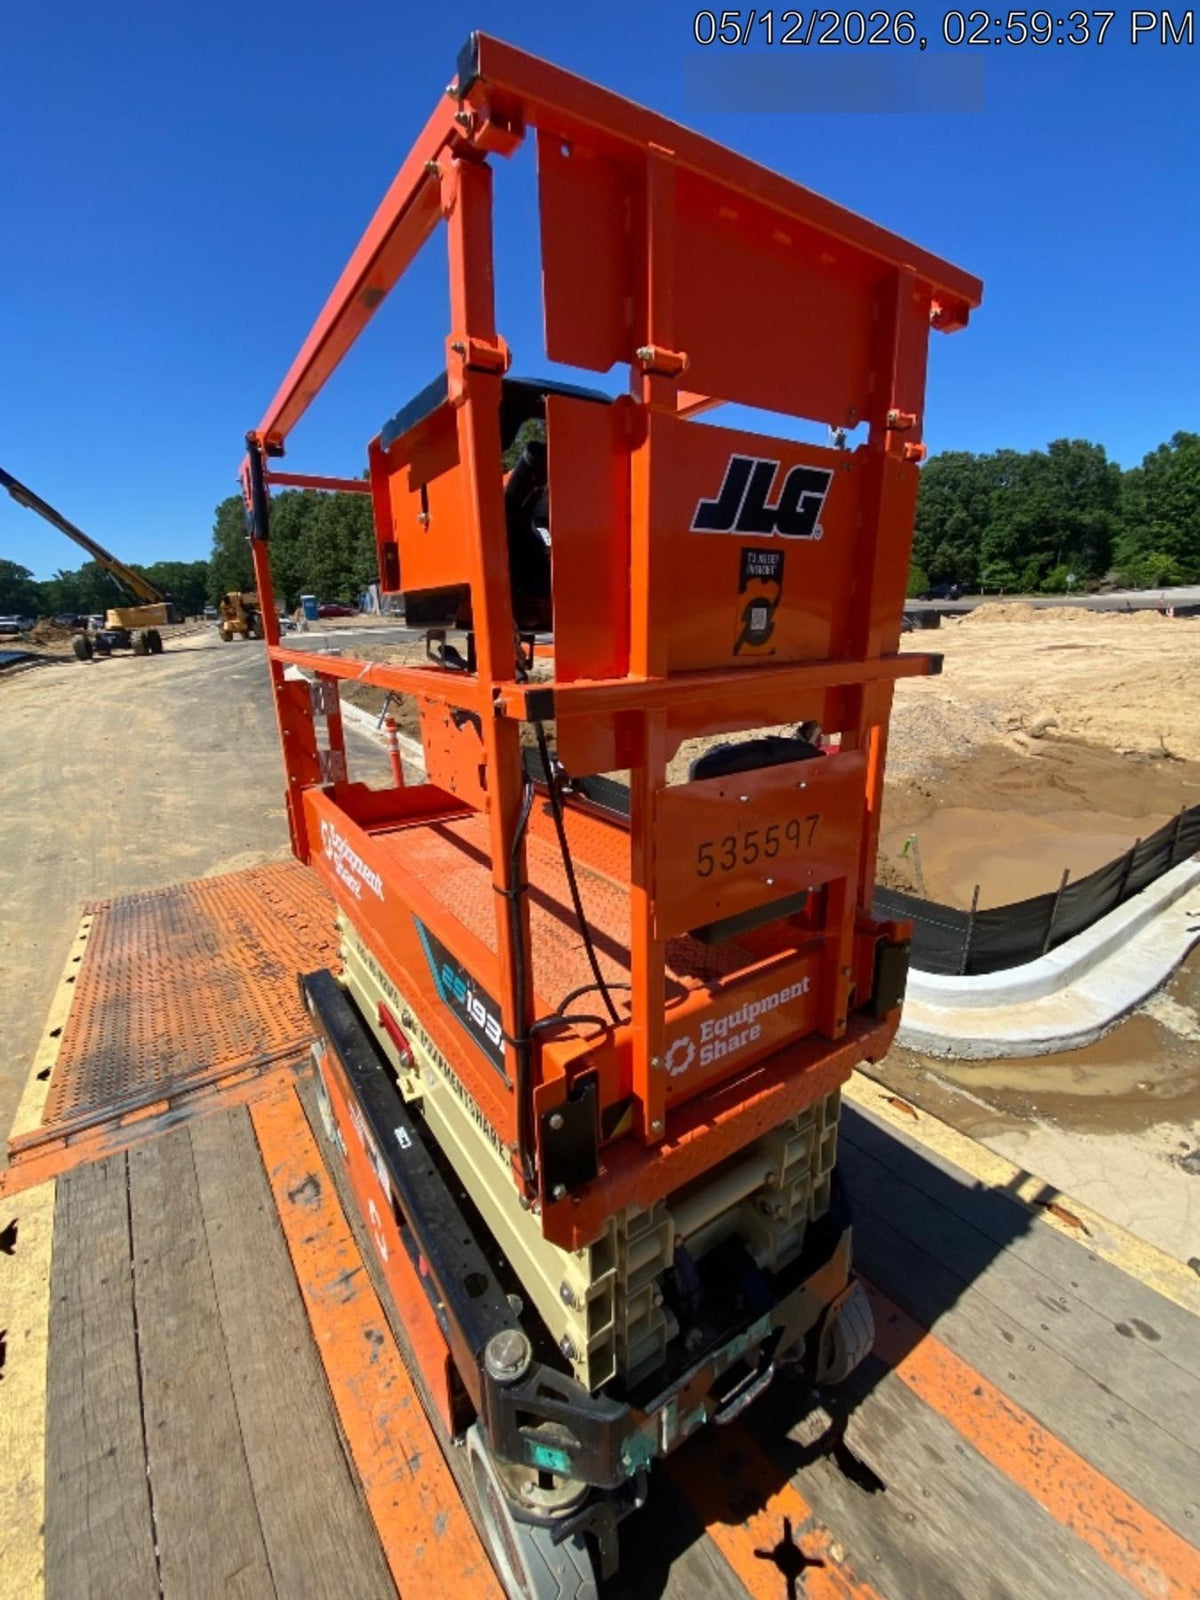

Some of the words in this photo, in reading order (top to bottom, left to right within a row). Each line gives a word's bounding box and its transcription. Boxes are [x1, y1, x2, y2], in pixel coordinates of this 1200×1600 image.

[690, 453, 834, 540] JLG
[696, 813, 820, 878] 535597
[700, 975, 811, 1043] Equipment
[700, 1024, 761, 1067] Share
